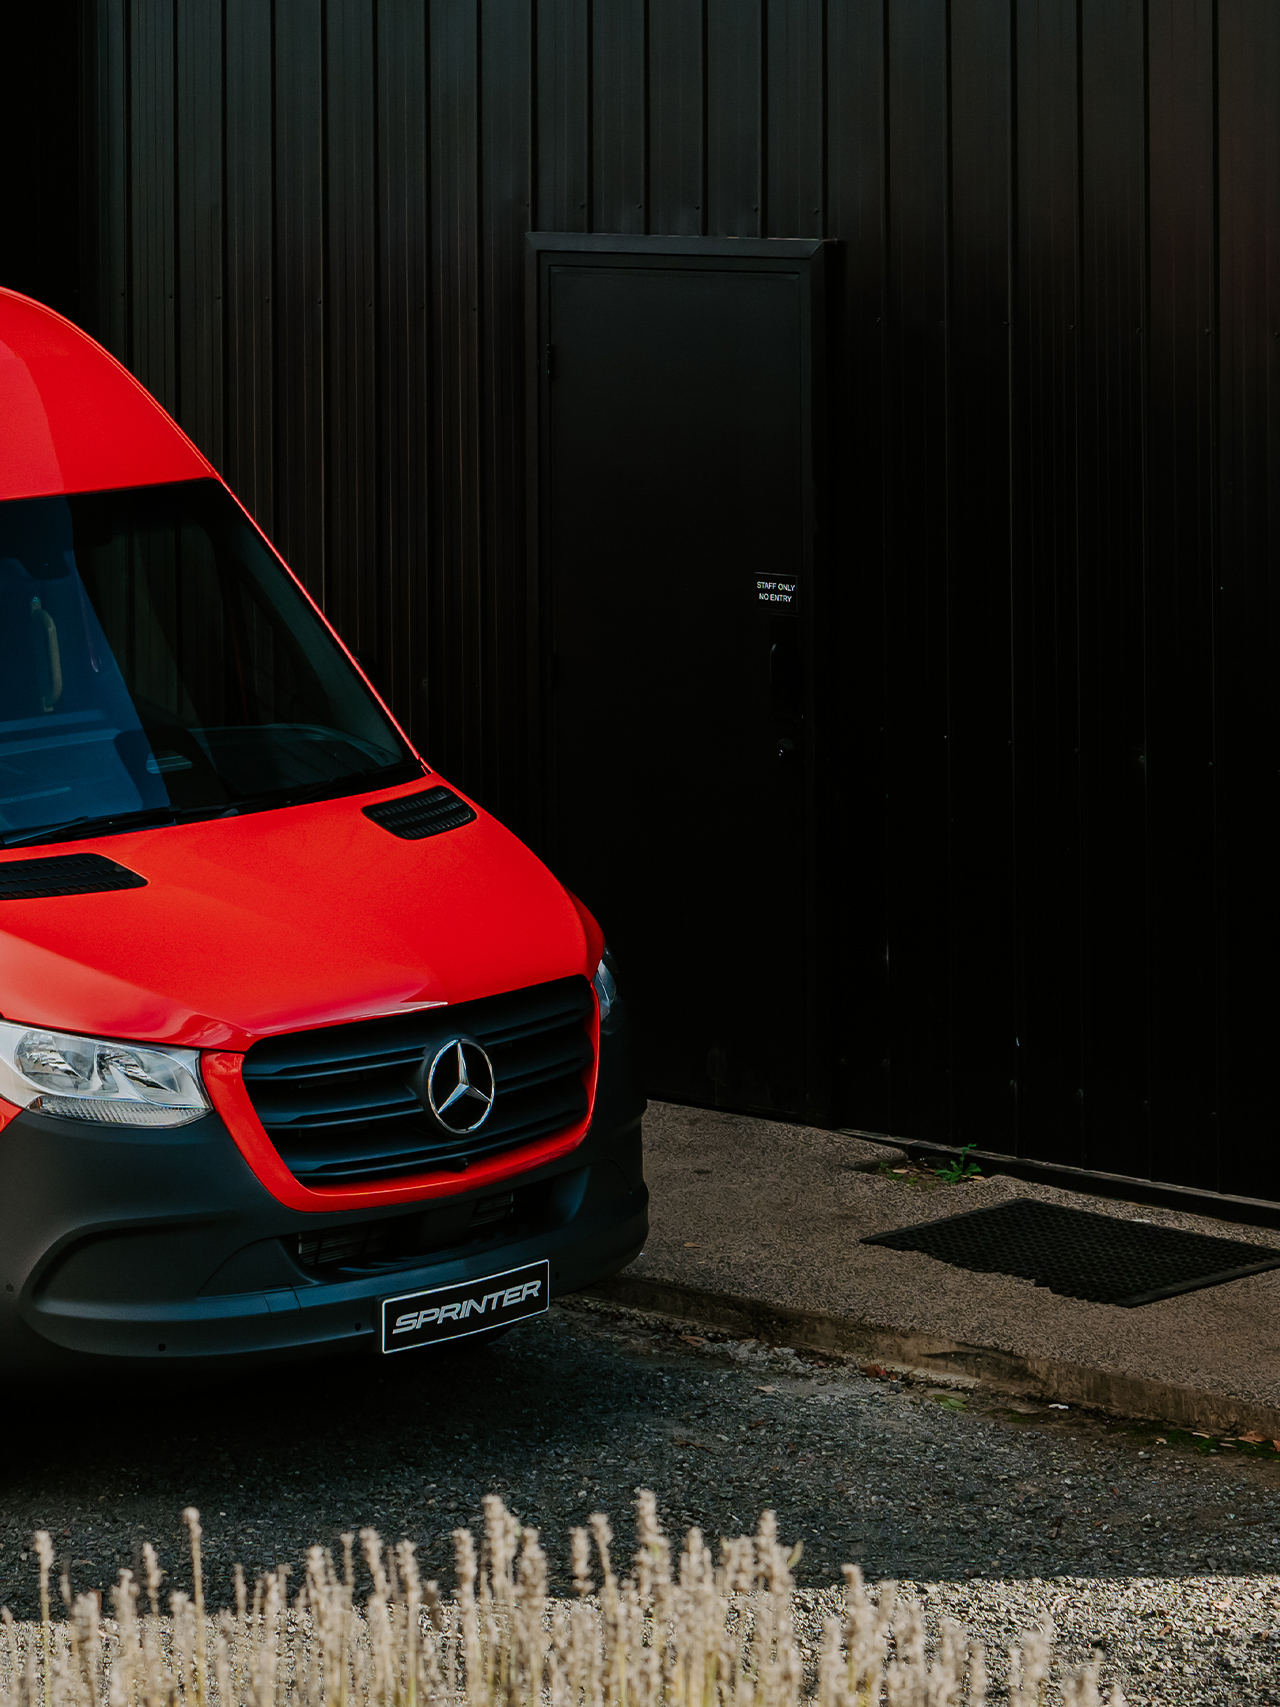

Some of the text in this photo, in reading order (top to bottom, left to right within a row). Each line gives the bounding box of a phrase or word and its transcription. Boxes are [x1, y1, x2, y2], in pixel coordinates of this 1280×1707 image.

[756, 581, 795, 591] STAFF ONLY
[759, 593, 792, 602] NO ENTRY
[392, 1280, 541, 1334] SPRINTER
